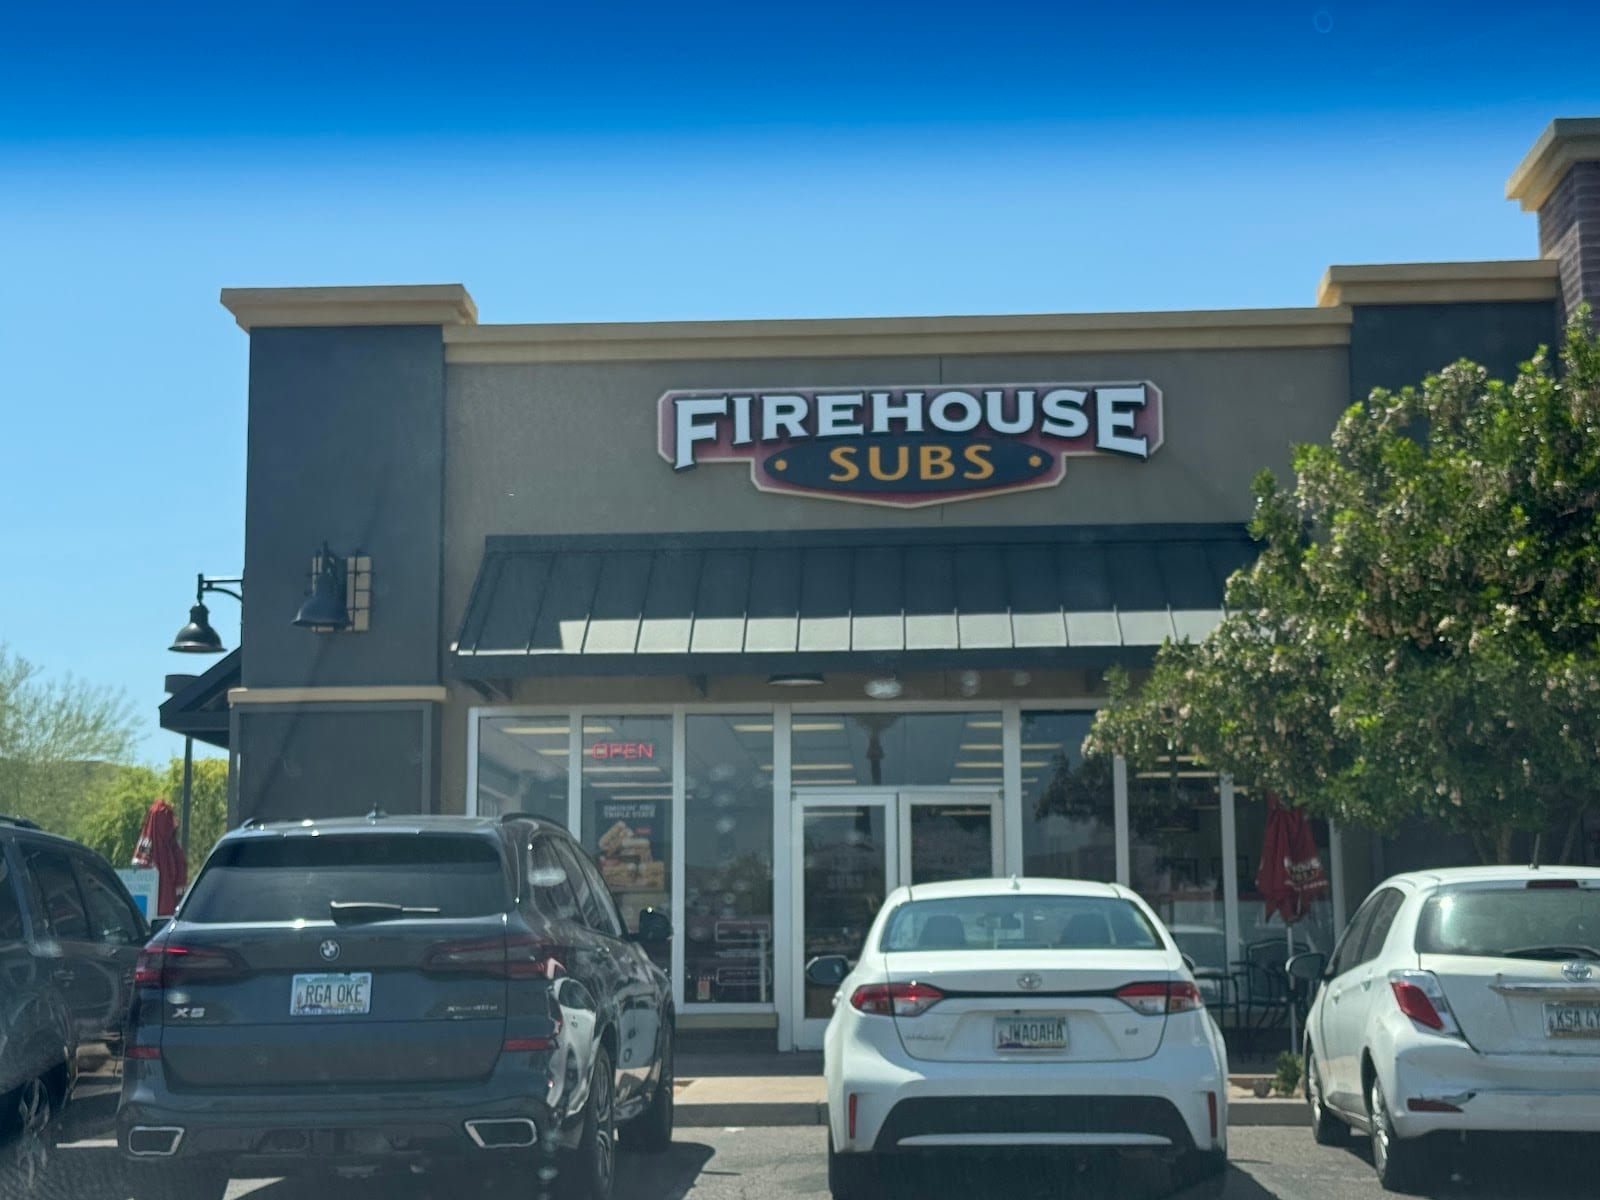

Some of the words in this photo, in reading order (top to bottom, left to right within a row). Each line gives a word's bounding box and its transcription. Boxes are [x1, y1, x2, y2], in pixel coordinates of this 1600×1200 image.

[674, 384, 1148, 470] FIREHOUSE
[829, 444, 994, 482] SUBS
[592, 743, 654, 759] OPEN
[305, 984, 332, 1004] RGA
